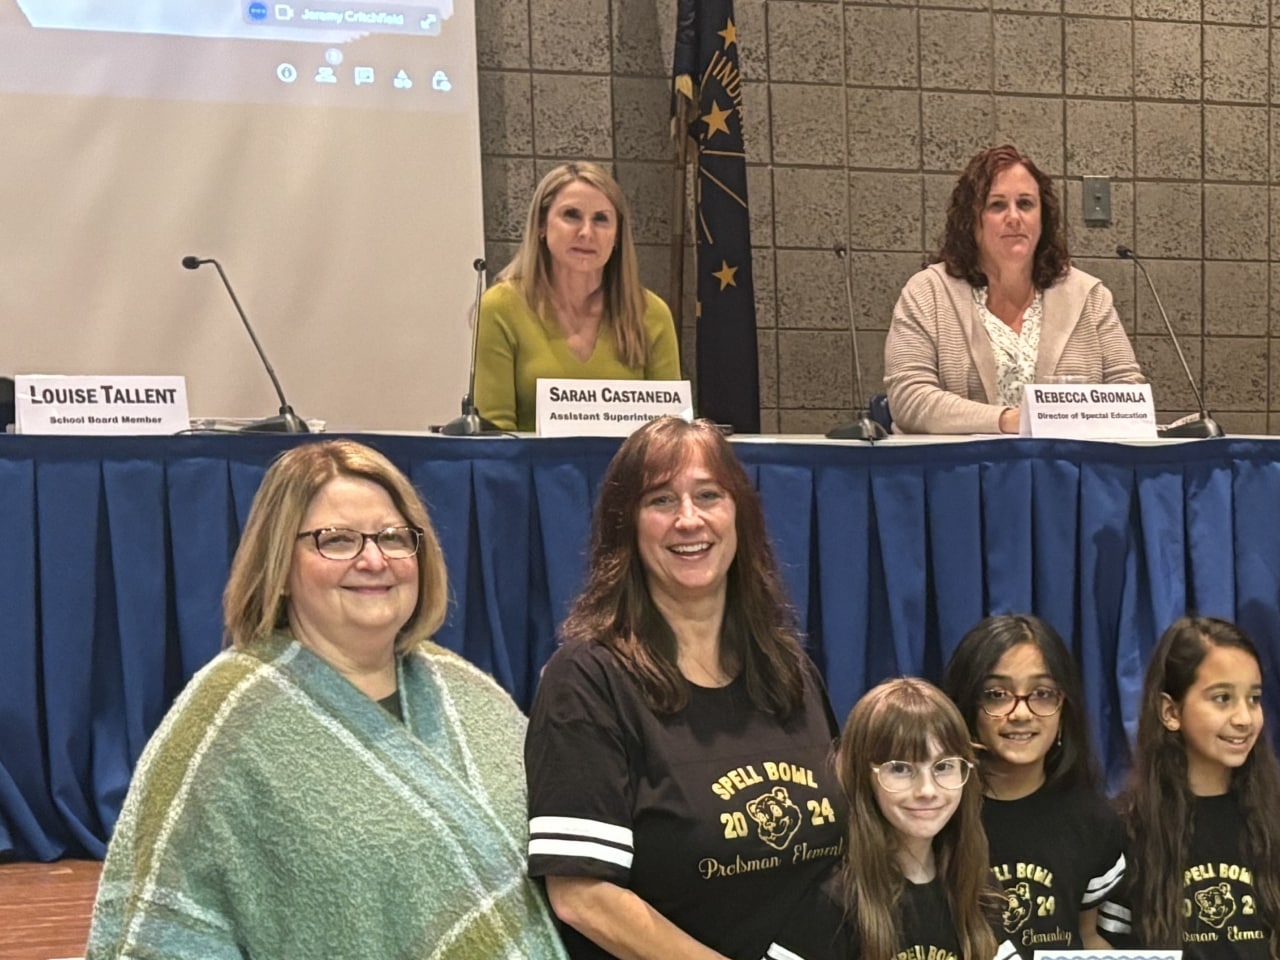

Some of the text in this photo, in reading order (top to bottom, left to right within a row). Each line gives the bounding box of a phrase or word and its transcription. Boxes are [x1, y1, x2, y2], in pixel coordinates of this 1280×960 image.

[301, 9, 343, 24] Jeremy
[30, 385, 177, 404] LOUISE TALLENT
[549, 386, 682, 404] SARAH CASTANEDA
[1034, 389, 1146, 403] REBECCA GROMALA
[50, 415, 162, 425] School Board Member
[549, 411, 600, 421] Assistant
[1037, 412, 1069, 420] Director
[1080, 412, 1108, 420] Special
[711, 761, 819, 800] SPELL BOWL
[720, 797, 836, 839] 20 24
[1016, 862, 1053, 888] BOWL
[1183, 862, 1217, 887] PELL
[1036, 895, 1055, 917] 24
[1241, 895, 1256, 915] 2
